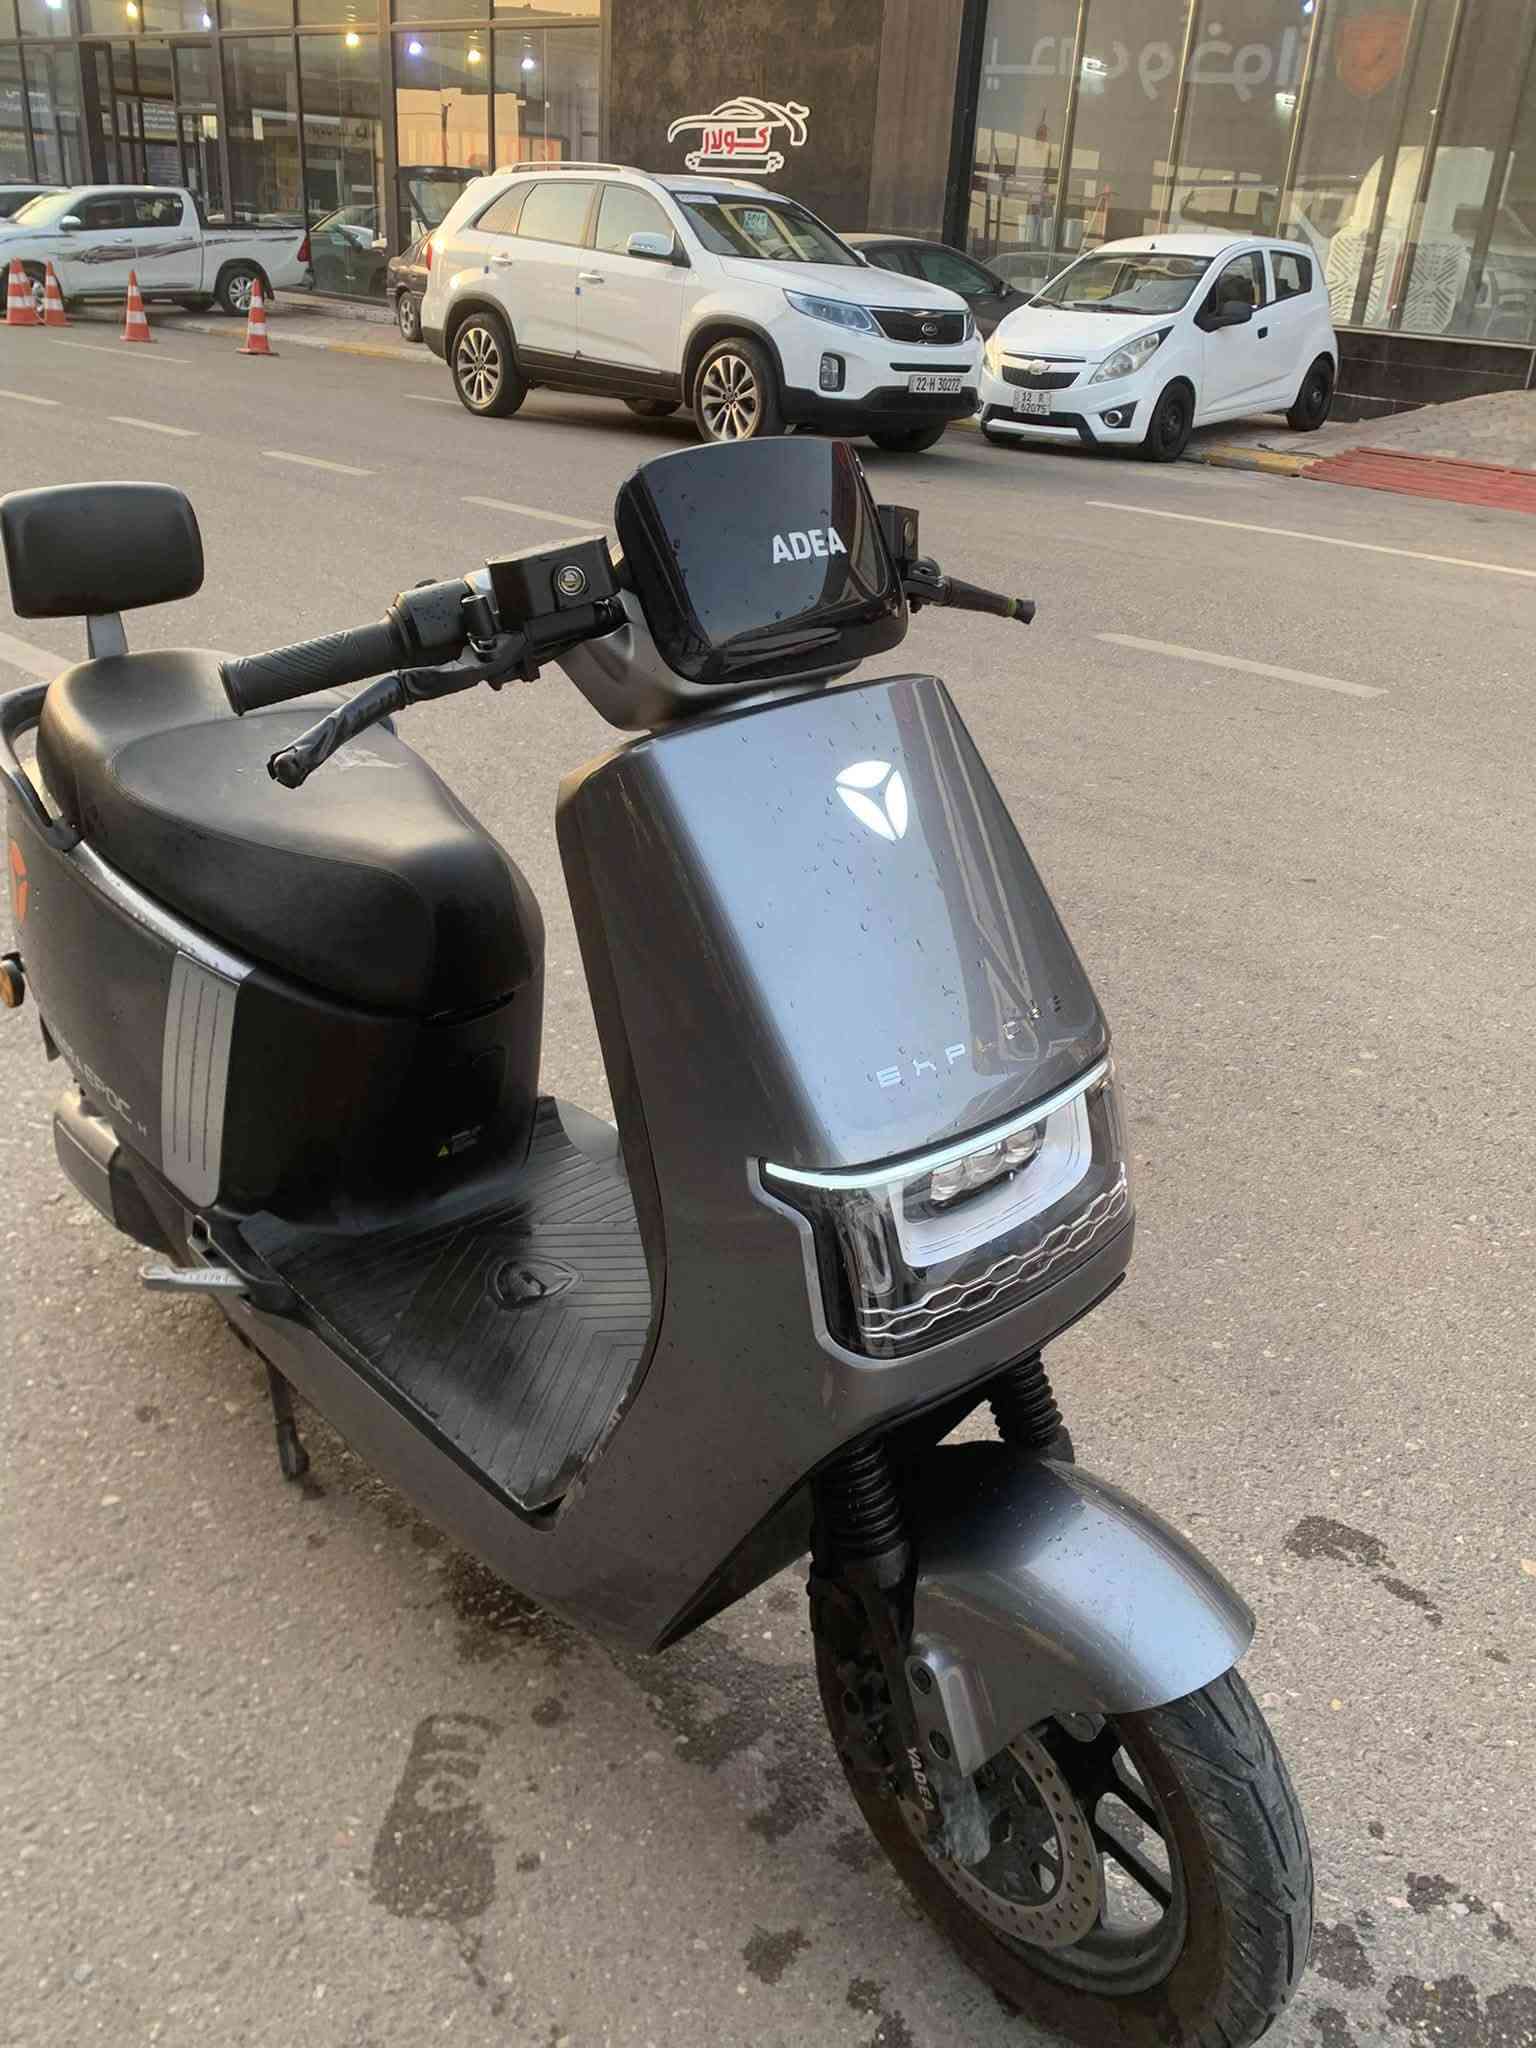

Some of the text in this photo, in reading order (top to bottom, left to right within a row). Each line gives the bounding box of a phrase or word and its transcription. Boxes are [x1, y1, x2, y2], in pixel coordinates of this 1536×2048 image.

[702, 127, 770, 154] كولار
[772, 527, 847, 564] ADEA
[905, 1746, 935, 1810] YADEA
